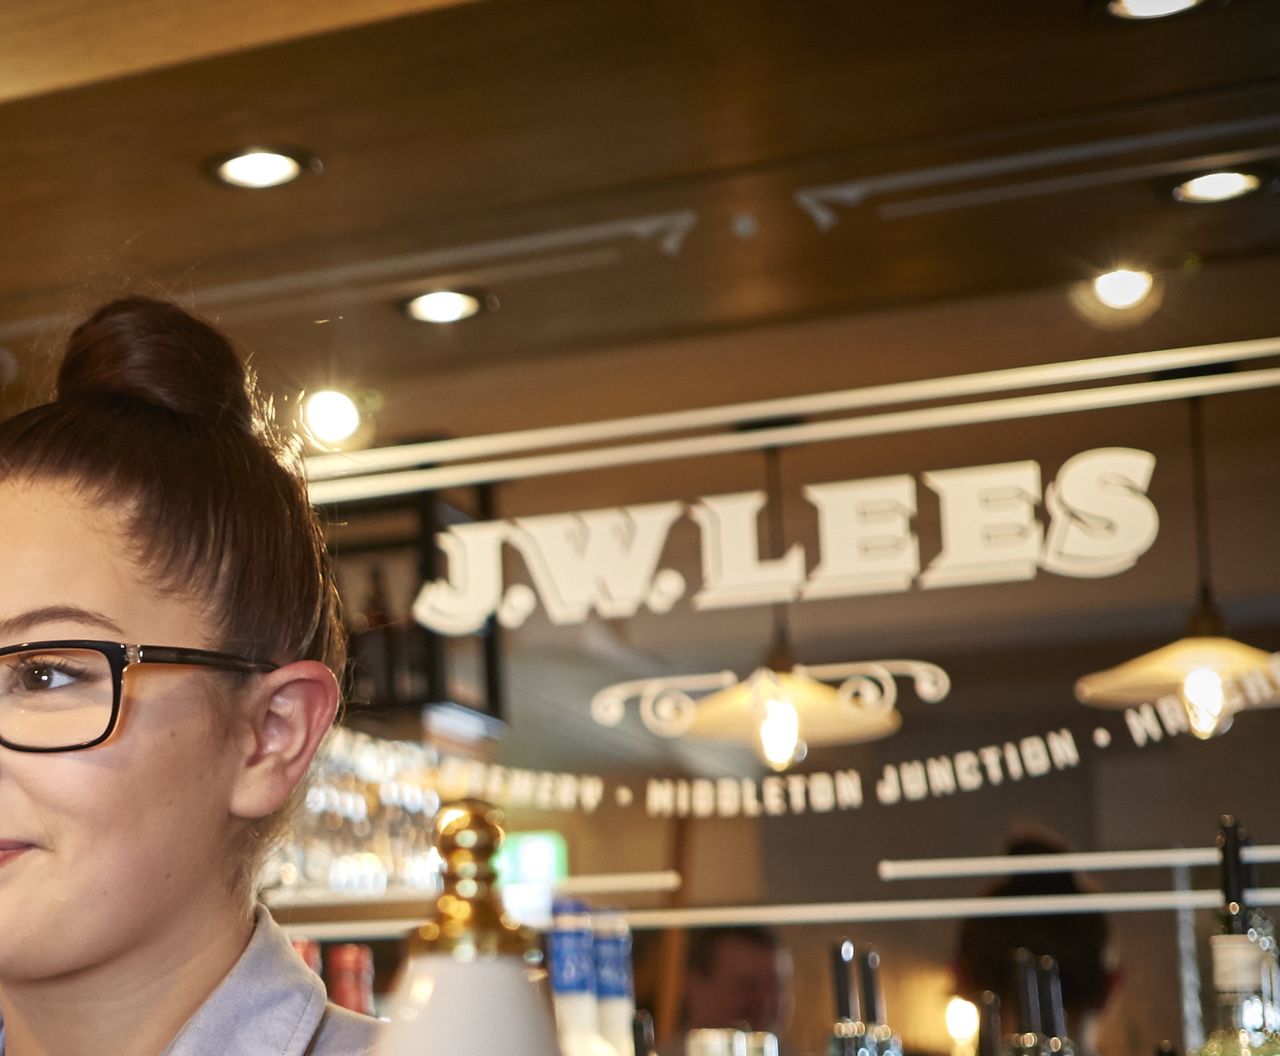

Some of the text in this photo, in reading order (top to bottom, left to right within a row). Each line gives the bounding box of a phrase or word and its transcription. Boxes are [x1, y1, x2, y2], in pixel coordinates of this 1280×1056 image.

[413, 445, 1159, 637] J.W.LEES
[646, 767, 861, 817] MIDDLETON
[876, 727, 1080, 805] JUNCTION
